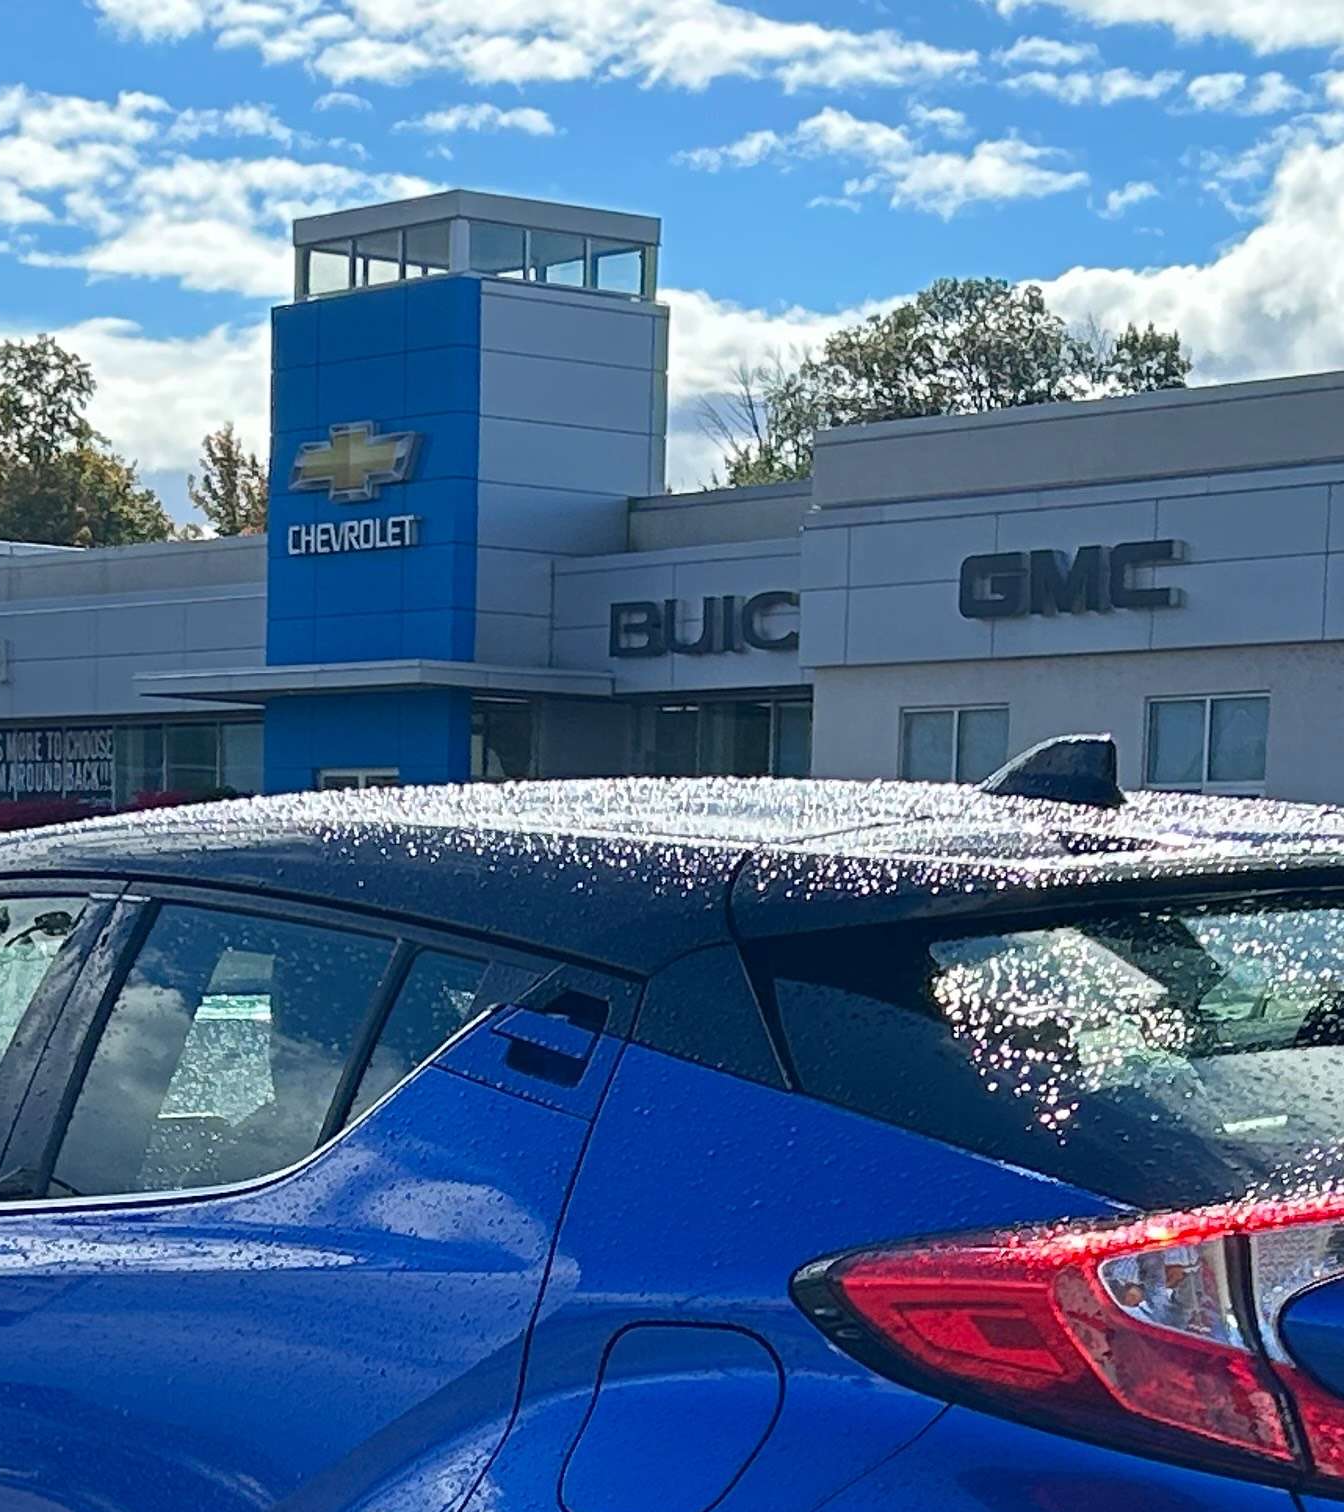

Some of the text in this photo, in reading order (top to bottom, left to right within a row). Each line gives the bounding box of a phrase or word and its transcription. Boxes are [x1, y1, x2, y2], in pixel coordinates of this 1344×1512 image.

[288, 514, 416, 555] CHEVROLET
[959, 539, 1182, 618] GMC
[6, 731, 44, 762] MORE
[47, 731, 64, 760] TO
[66, 729, 113, 760] CHOOSE
[8, 762, 63, 792] AROUND
